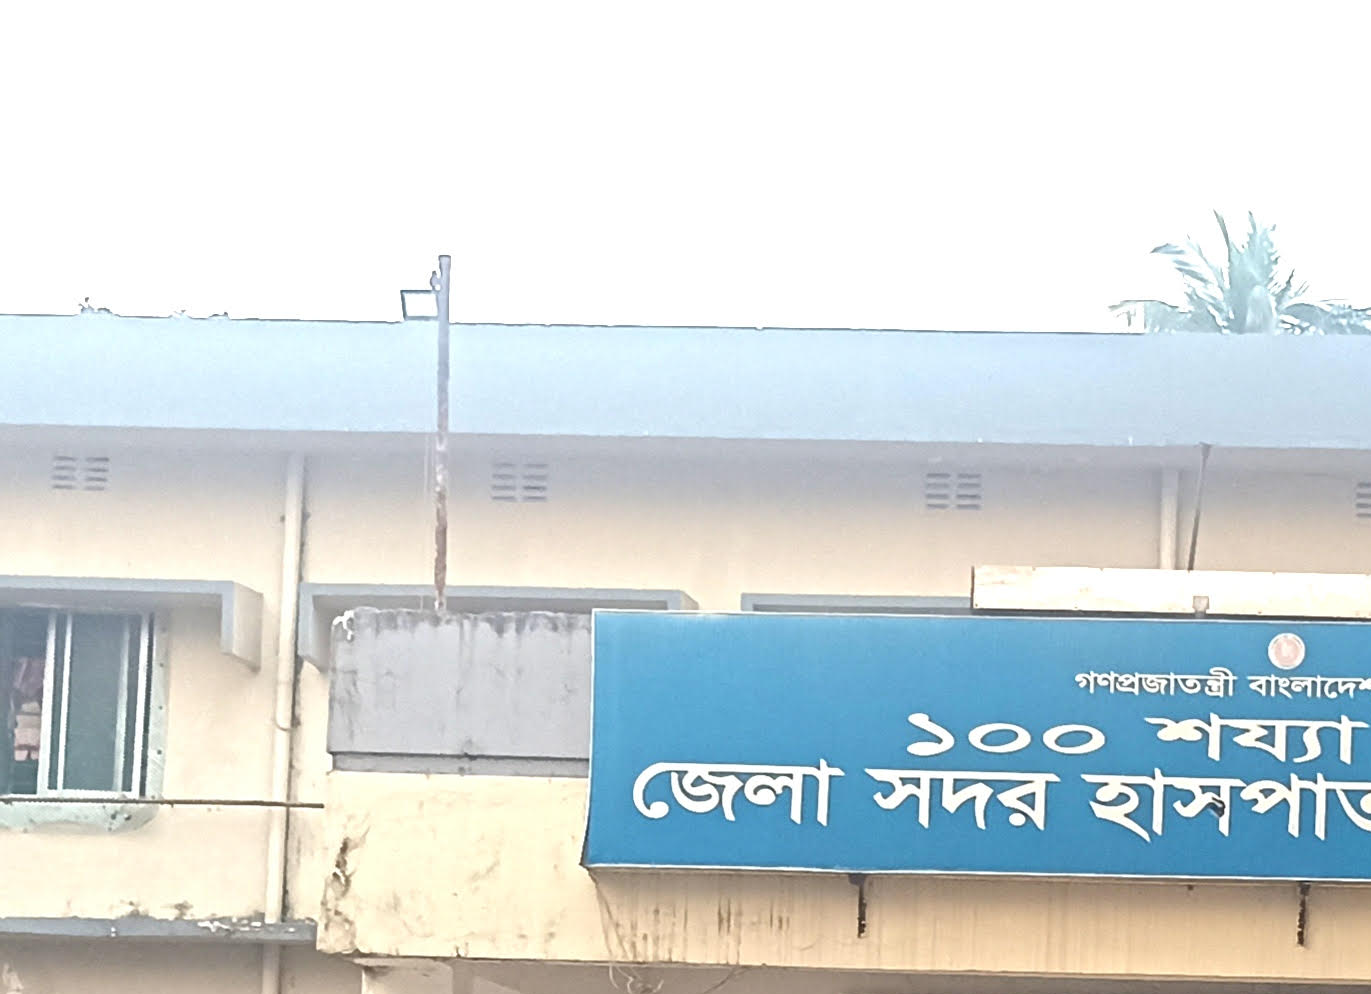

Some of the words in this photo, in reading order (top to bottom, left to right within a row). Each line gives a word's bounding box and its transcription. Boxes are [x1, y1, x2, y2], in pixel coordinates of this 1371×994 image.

[1074, 666, 1238, 698] গণপ্রজাতন্ত্রী
[906, 712, 1106, 757] ১০০
[1144, 712, 1369, 765] শয্যা
[632, 758, 845, 827] জেলা
[864, 767, 1061, 831] সদর
